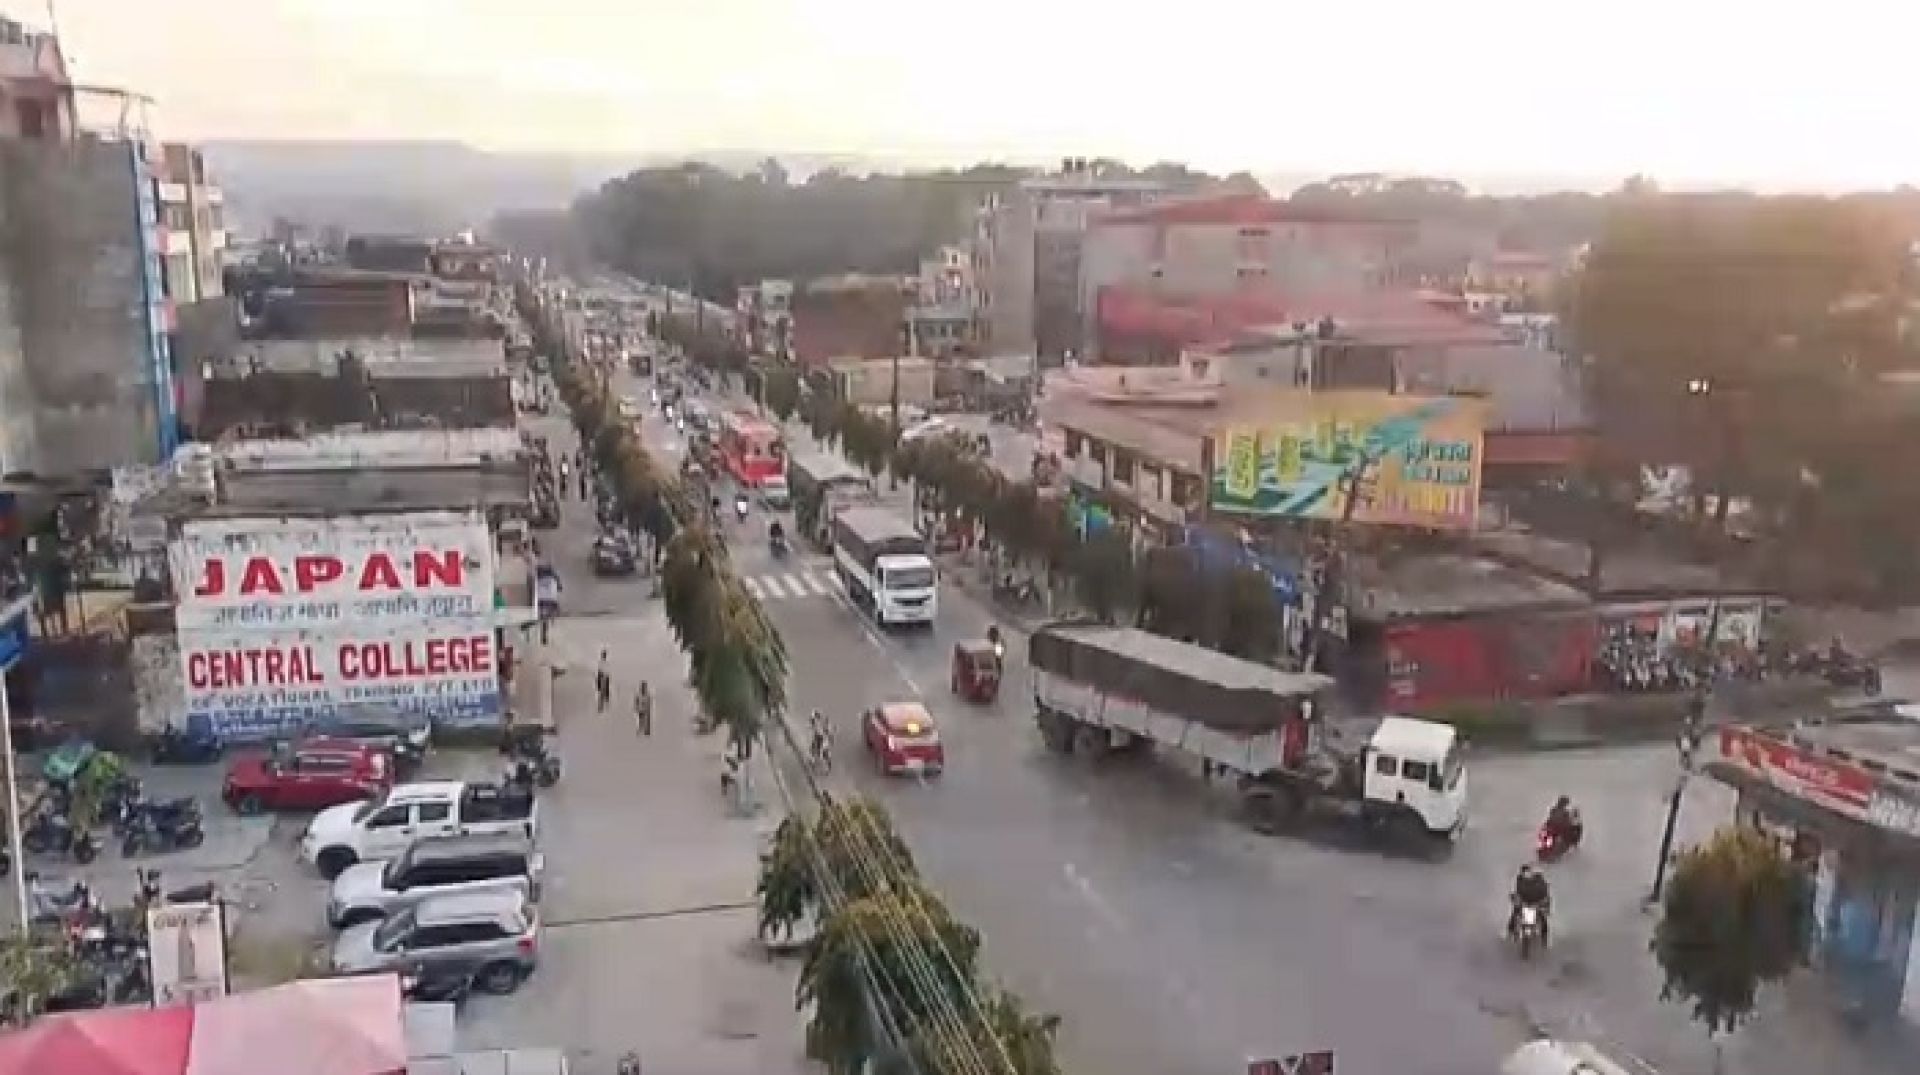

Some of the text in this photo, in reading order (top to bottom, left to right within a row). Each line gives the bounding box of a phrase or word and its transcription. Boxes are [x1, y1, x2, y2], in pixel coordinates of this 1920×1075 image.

[194, 551, 463, 596] JAPAN
[188, 635, 491, 689] CENTRAL COLLEGE
